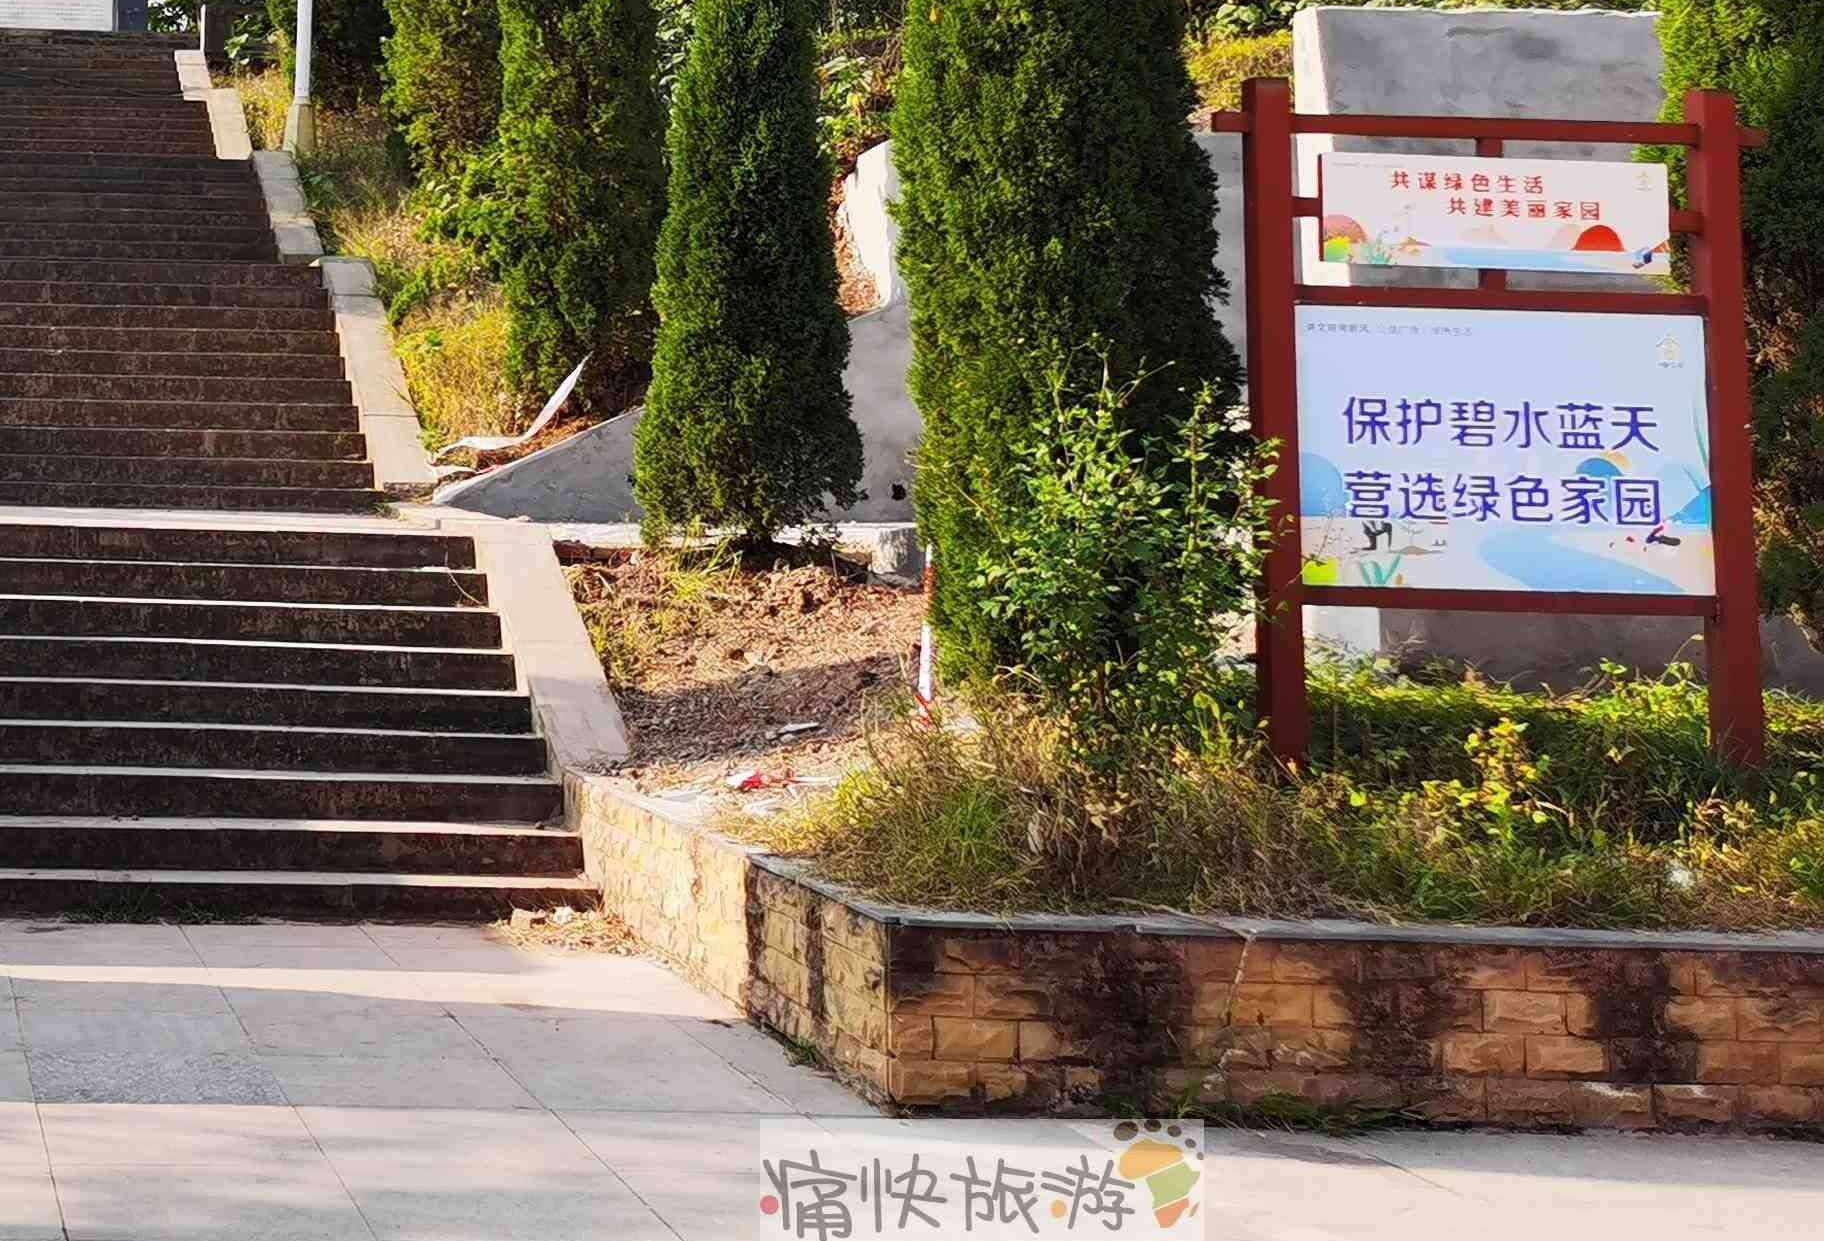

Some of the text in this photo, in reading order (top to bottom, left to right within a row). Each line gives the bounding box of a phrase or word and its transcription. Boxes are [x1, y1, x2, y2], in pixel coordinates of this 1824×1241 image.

[1390, 171, 1544, 194] 共谋绿色生活
[1447, 197, 1601, 221] 共建美丽家园
[1342, 396, 1660, 452] 保护碧水蓝天
[1343, 470, 1663, 526] 营选绿色家园
